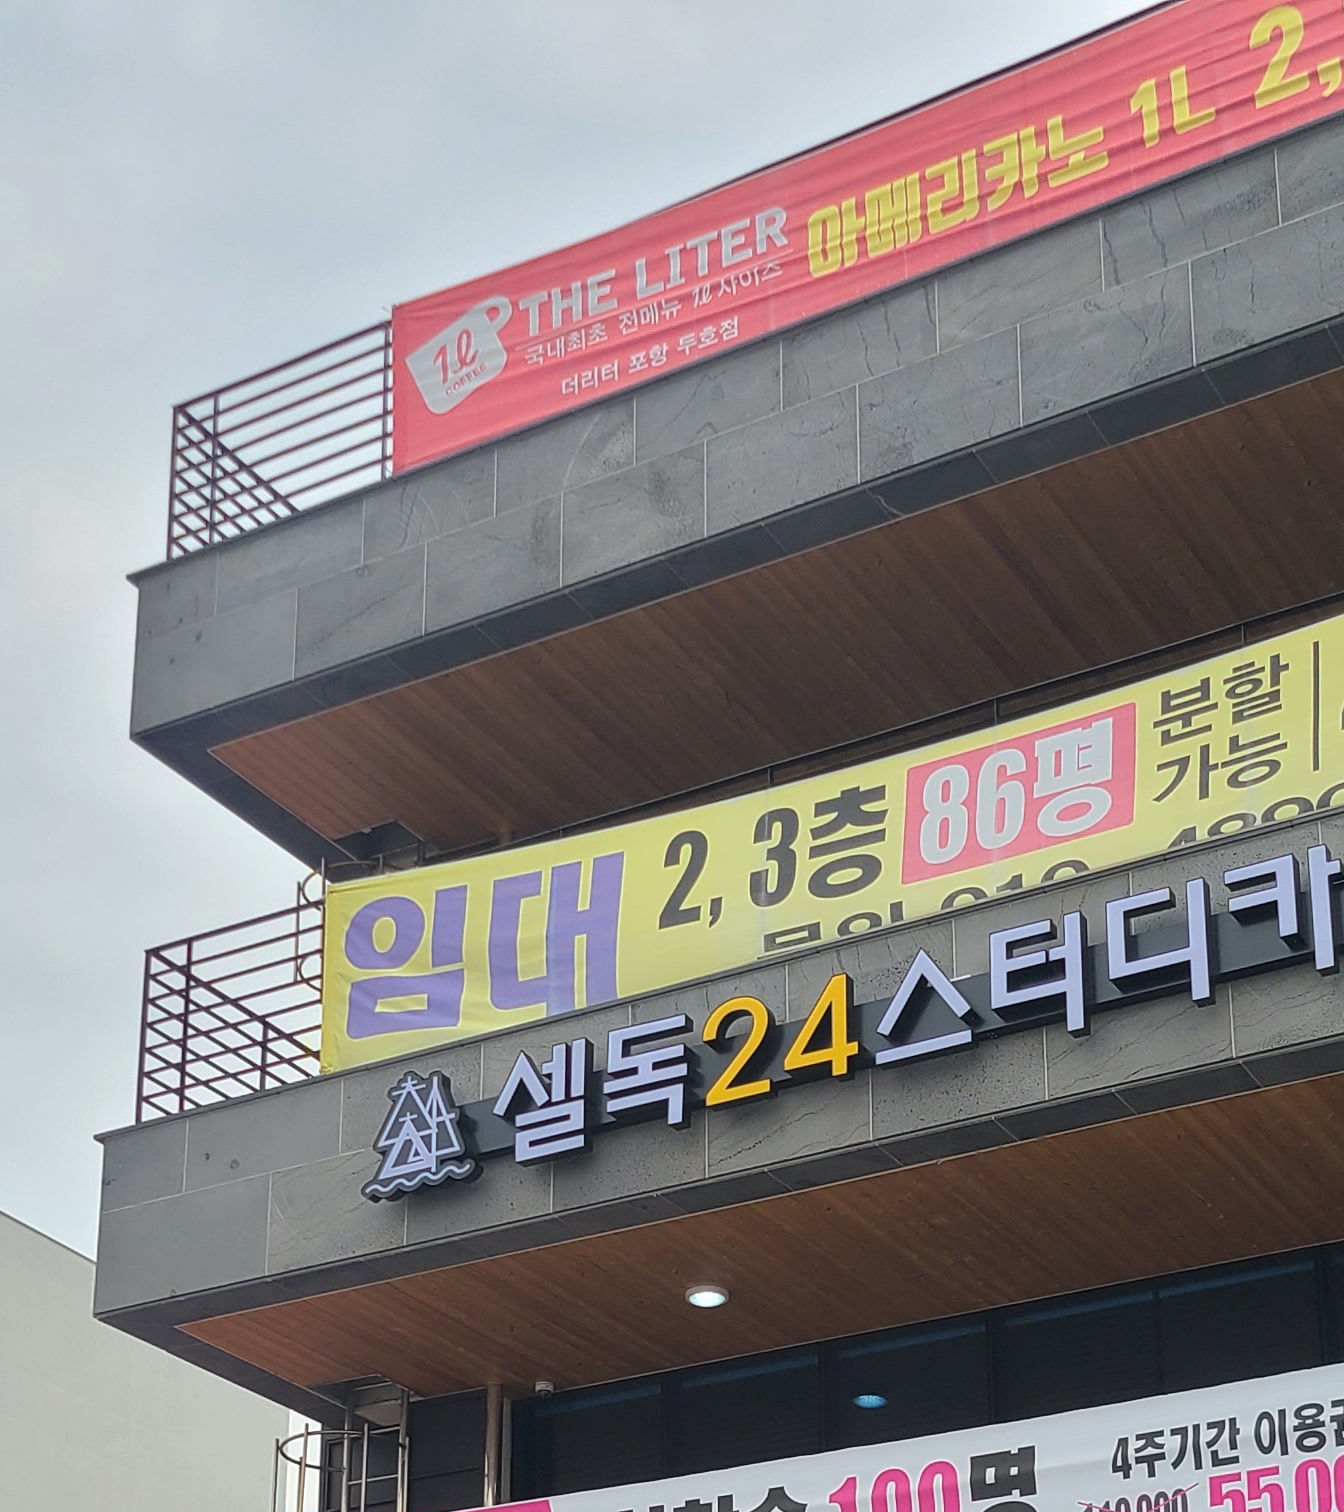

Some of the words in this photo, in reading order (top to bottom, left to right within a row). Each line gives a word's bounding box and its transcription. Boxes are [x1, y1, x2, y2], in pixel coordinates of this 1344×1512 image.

[806, 114, 1110, 279] 아메리카노
[1129, 65, 1217, 149] 1L
[518, 269, 617, 337] THE
[635, 206, 789, 300] LITER
[524, 322, 609, 366] 국내최초
[619, 298, 682, 336] 전메뉴
[716, 260, 784, 300] 사이즈
[445, 363, 488, 396] COFFEE
[561, 361, 621, 397] 더리터
[628, 343, 669, 376] 포항
[677, 316, 741, 356] 두호점
[1153, 645, 1290, 746] 분할
[1153, 728, 1290, 802] 가능
[343, 850, 625, 1043] 임대
[918, 714, 1115, 866] 86평
[1112, 1414, 1241, 1480] 4주기간
